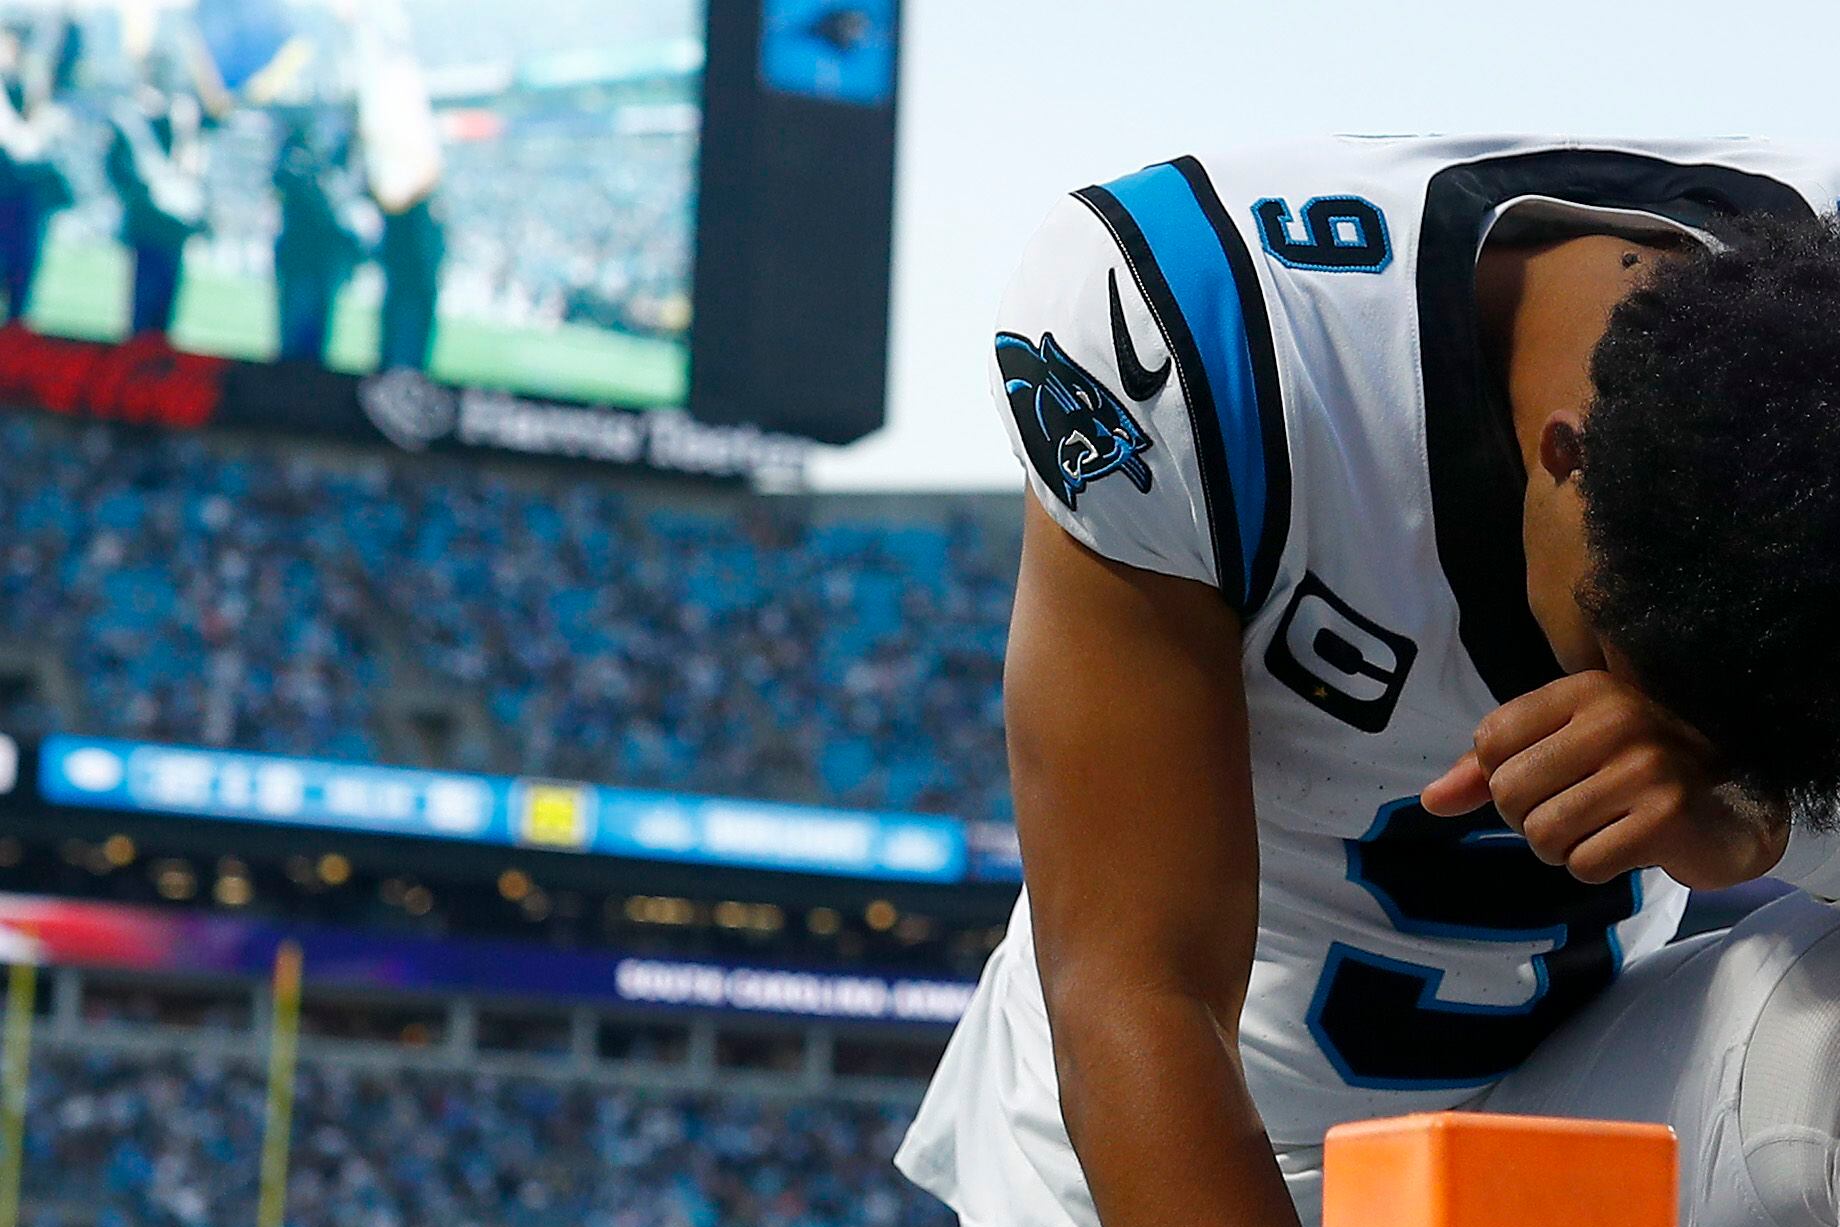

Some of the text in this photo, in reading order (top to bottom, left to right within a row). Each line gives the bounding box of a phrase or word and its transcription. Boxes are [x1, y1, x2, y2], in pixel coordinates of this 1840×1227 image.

[1251, 196, 1395, 273] 9
[1287, 594, 1396, 702] C
[1305, 793, 1642, 1092] 9
